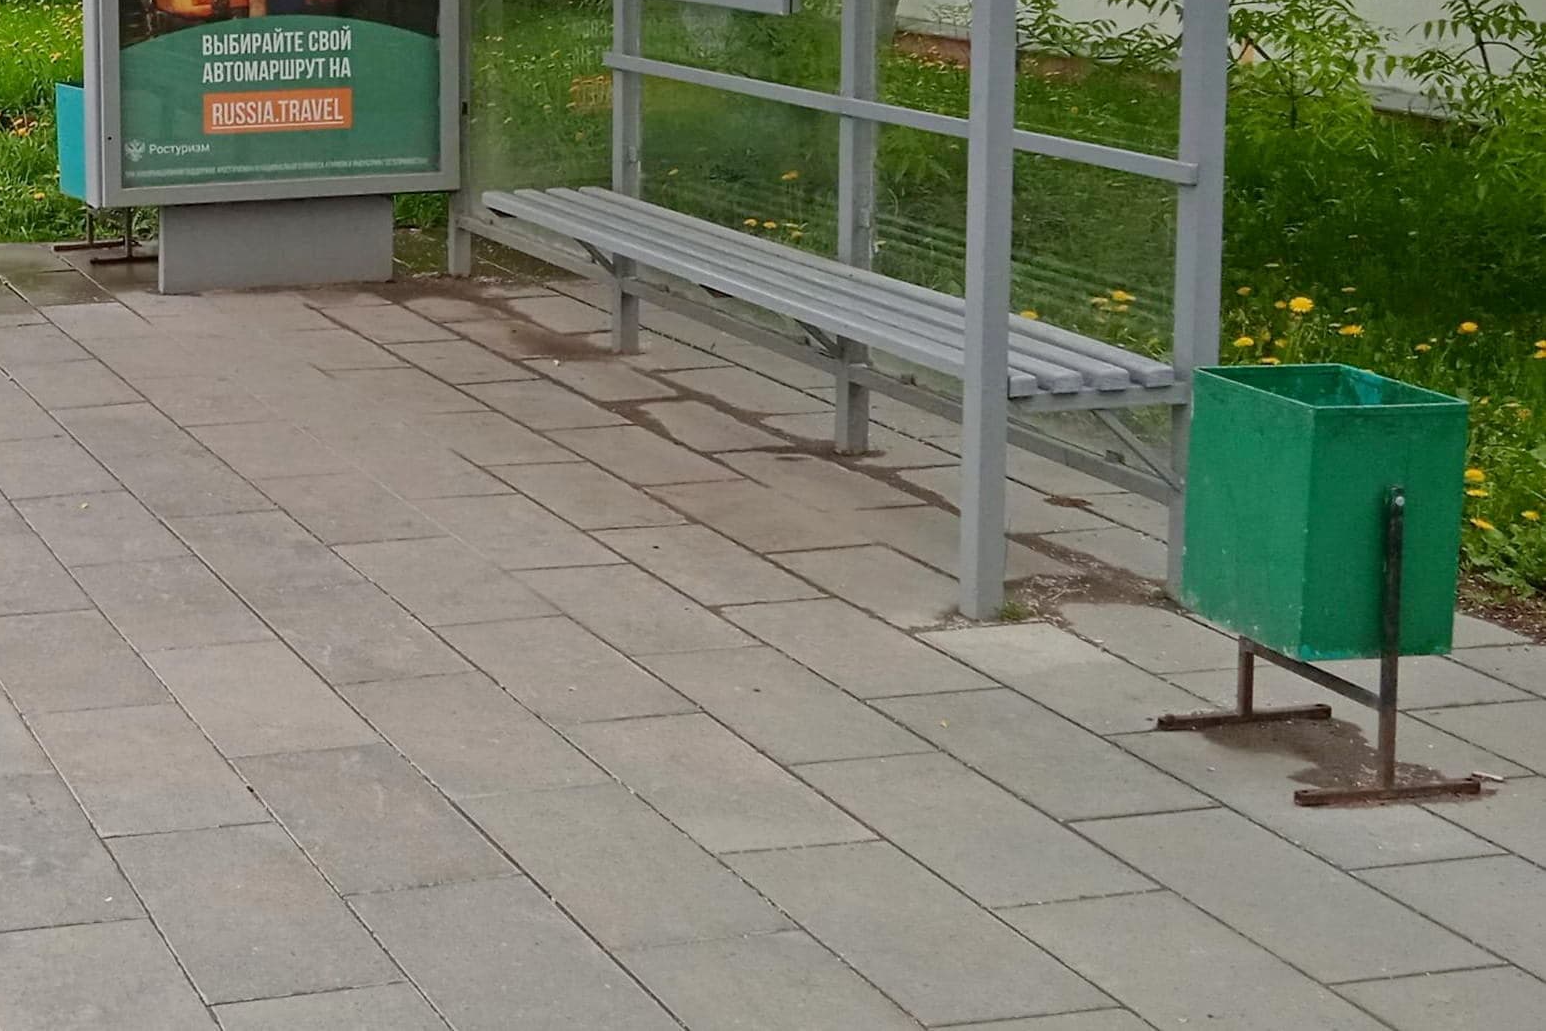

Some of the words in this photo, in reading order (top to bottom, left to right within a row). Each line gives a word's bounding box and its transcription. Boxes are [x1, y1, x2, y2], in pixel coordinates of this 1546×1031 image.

[202, 27, 304, 57] ВЫБИРАЙТЕ
[308, 25, 353, 53] СВОЙ
[202, 58, 326, 84] АВТОМАРШРУТ
[329, 56, 352, 79] НА
[211, 97, 344, 127] RUSSIA.TRAVEL
[149, 143, 211, 157] Ростуризм
